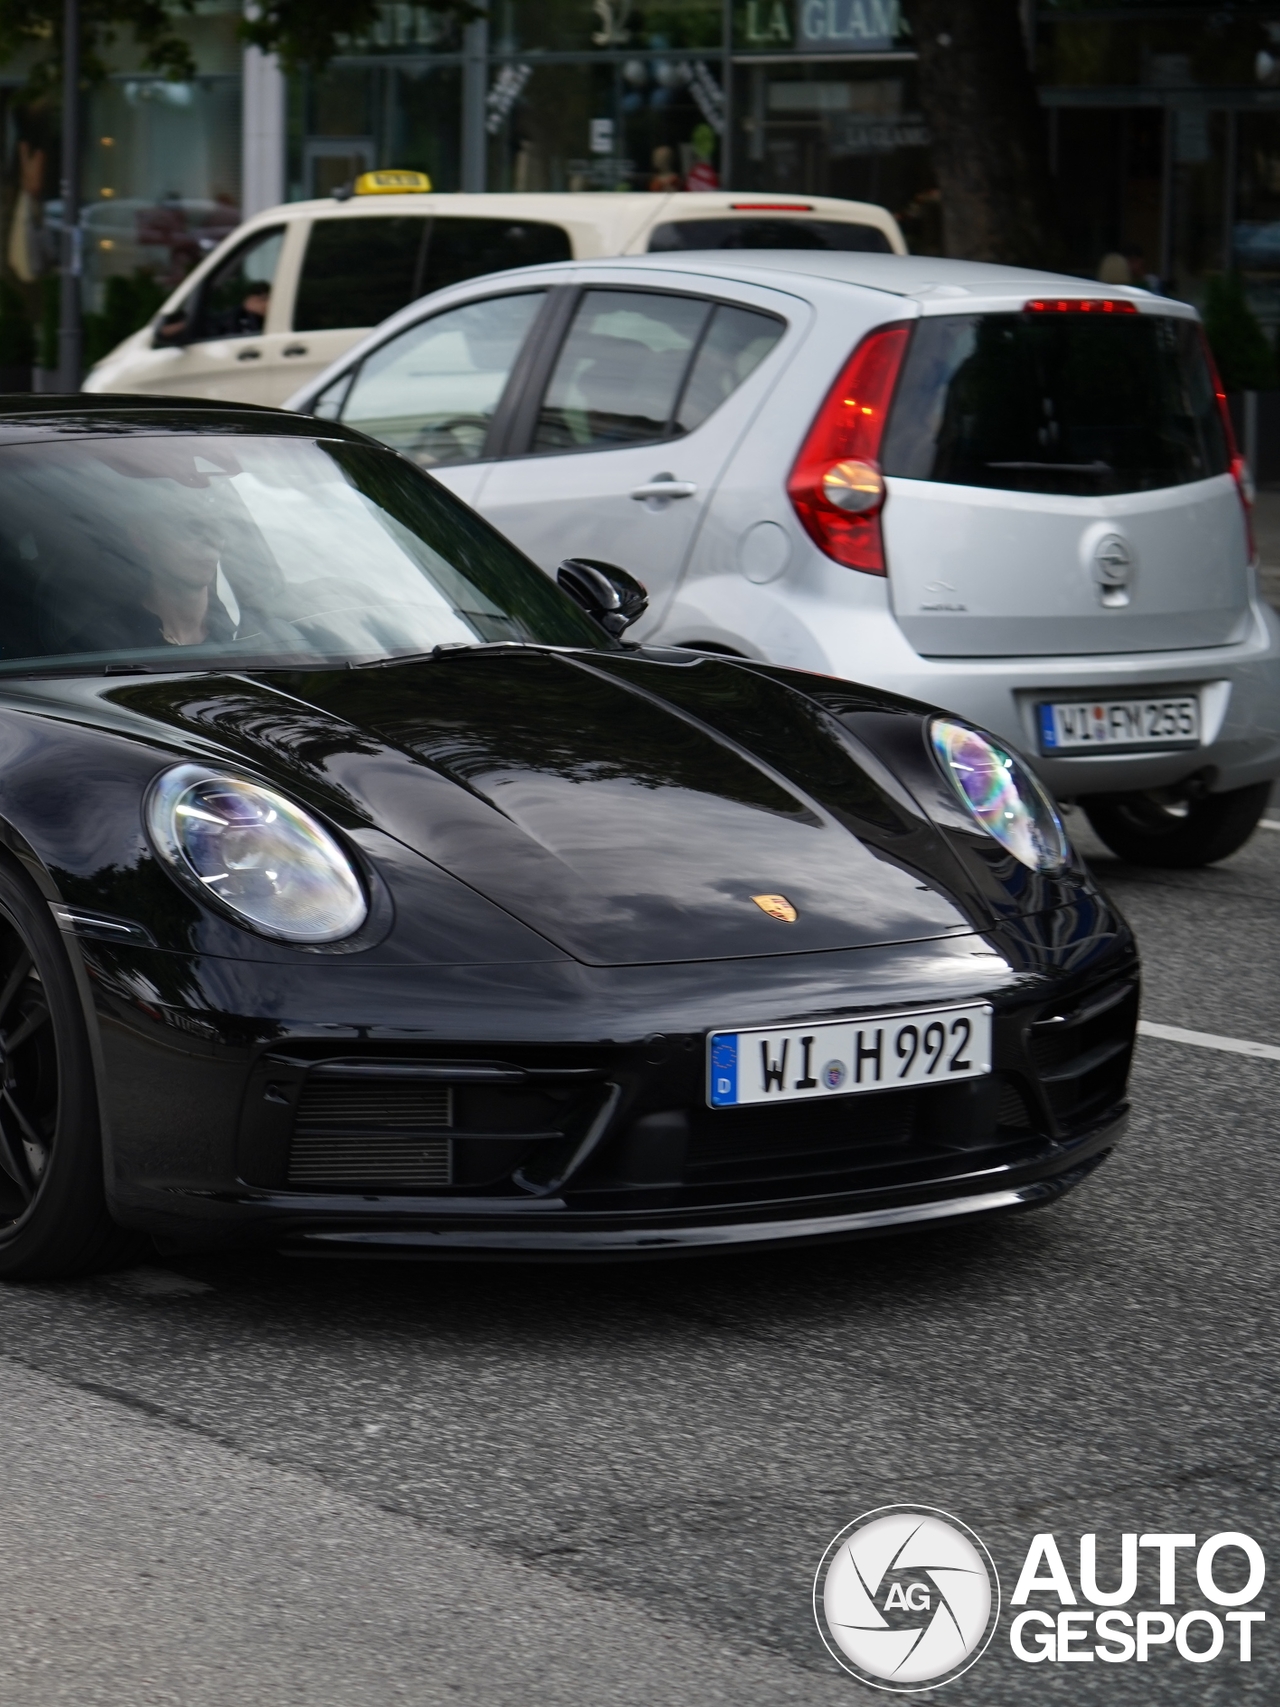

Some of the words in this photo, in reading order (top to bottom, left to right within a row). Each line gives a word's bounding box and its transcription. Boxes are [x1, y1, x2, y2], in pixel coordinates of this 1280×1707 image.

[746, 0, 790, 40] LA
[1058, 707, 1092, 740] WI
[717, 1078, 731, 1094] D
[759, 1036, 817, 1092] WI
